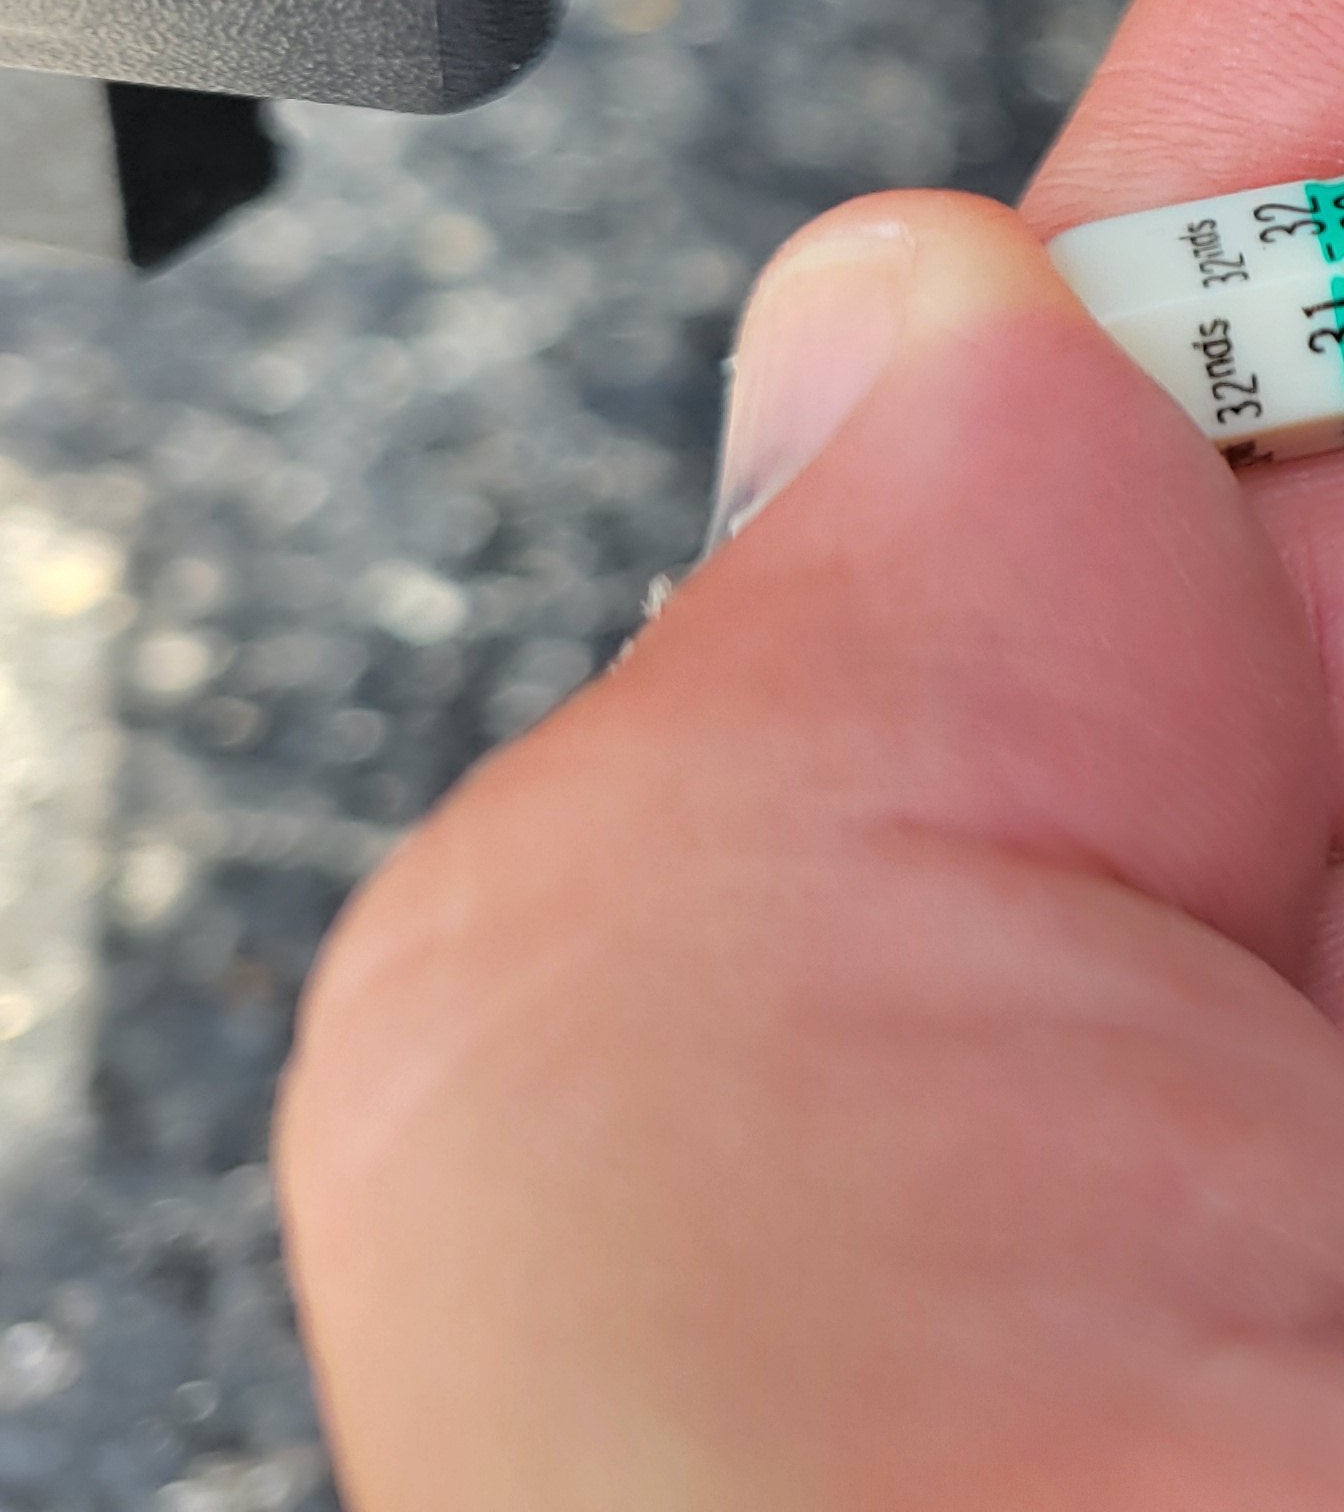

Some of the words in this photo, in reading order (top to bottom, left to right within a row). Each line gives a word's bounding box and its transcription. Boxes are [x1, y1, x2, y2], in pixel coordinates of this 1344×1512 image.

[1178, 219, 1249, 288] 32nds
[1254, 196, 1326, 245] 32
[1194, 318, 1265, 425] 32nds
